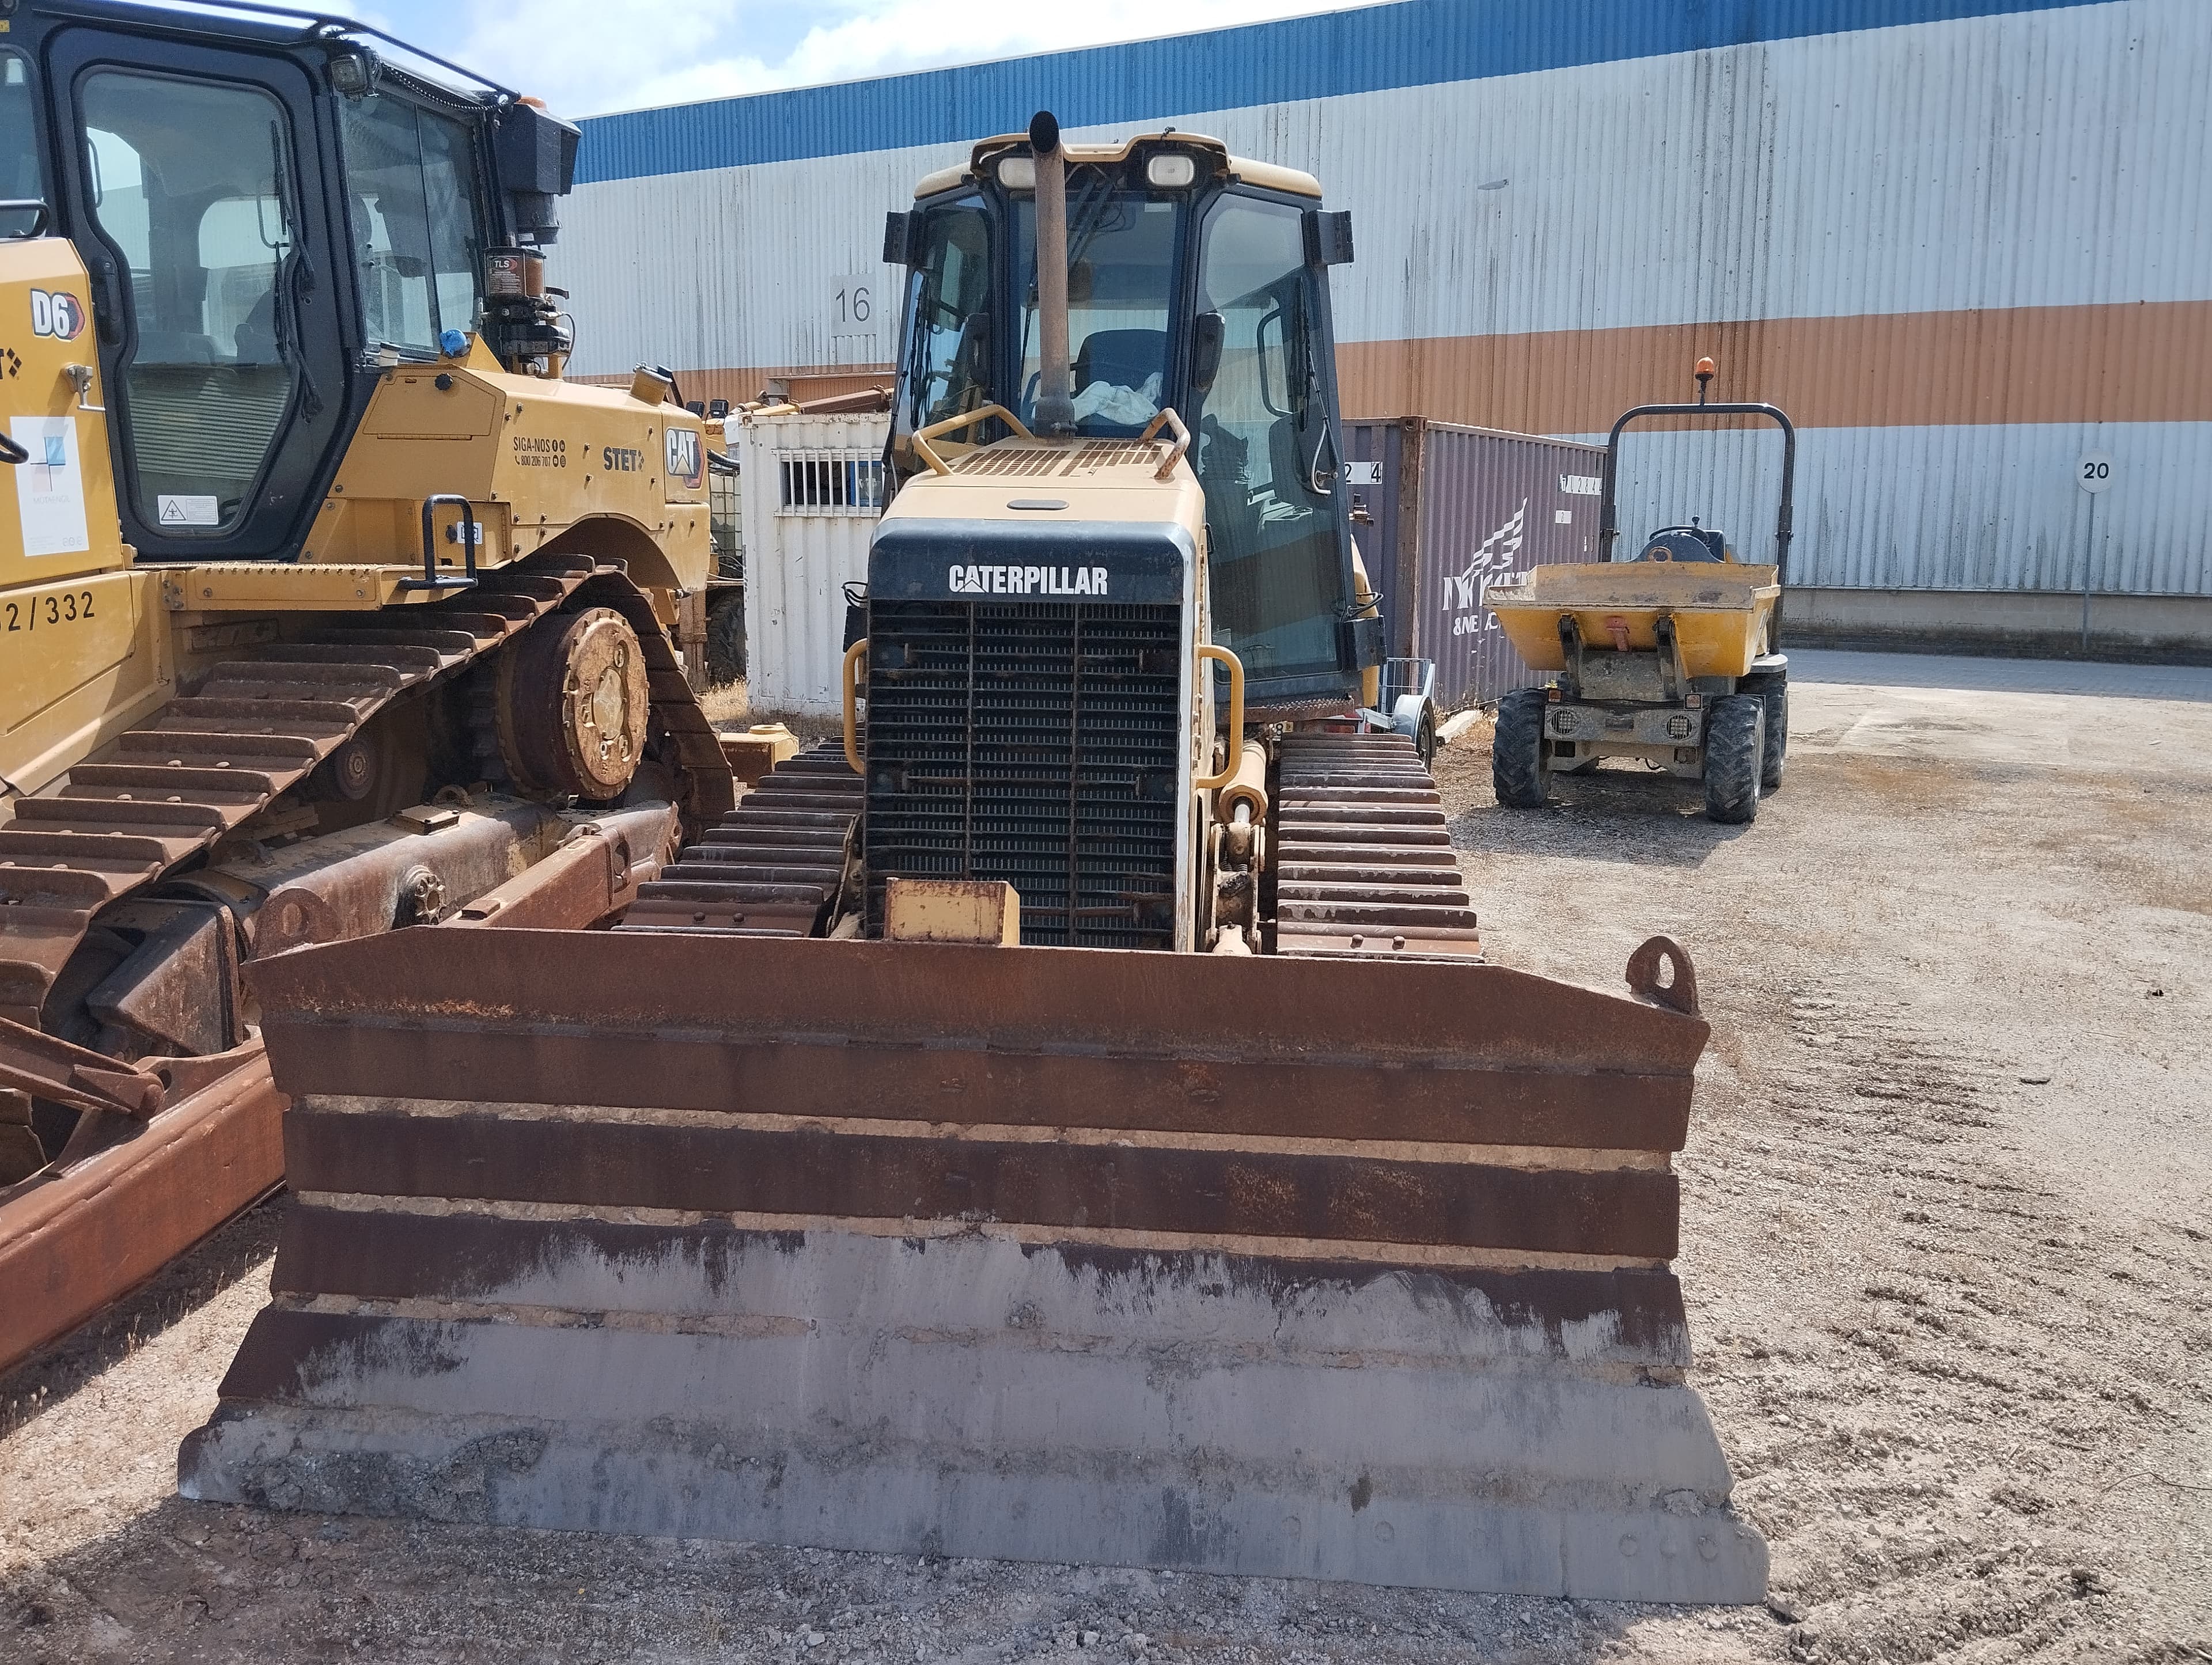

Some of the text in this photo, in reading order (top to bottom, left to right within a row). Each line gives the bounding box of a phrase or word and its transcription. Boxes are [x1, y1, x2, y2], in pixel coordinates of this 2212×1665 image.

[494, 260, 510, 268] TLS
[32, 291, 70, 337] D6
[835, 287, 870, 323] 16
[513, 436, 550, 453] SIGA-NOS
[666, 429, 696, 475] CAT
[521, 455, 531, 466] 800
[541, 456, 551, 467] 707
[603, 446, 637, 472] STET
[2084, 462, 2109, 479] 20
[949, 564, 1108, 595] CATERPILLAR
[0, 591, 95, 631] 2/332
